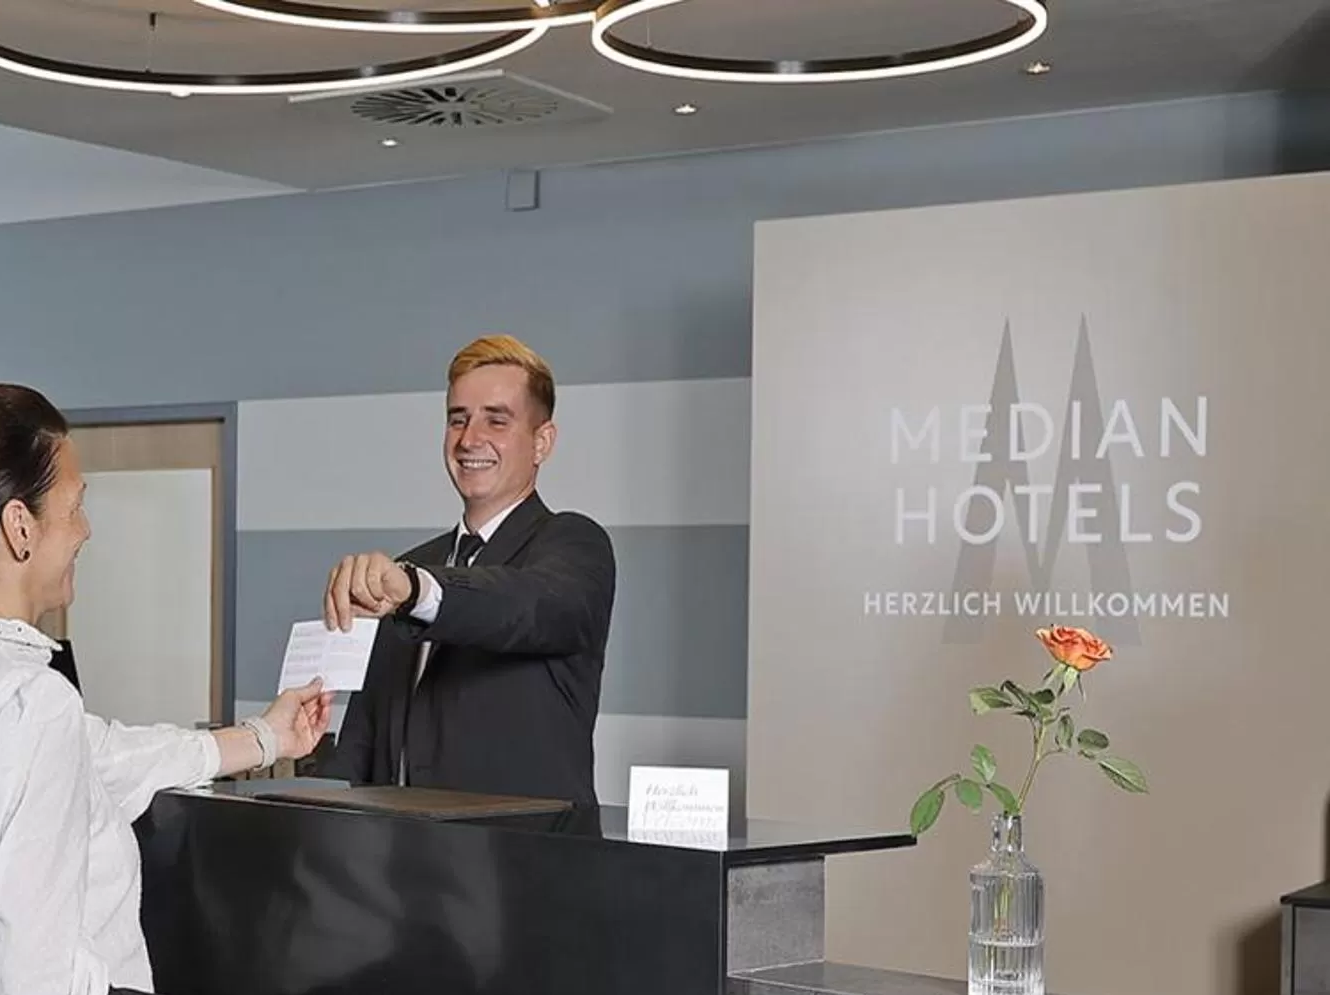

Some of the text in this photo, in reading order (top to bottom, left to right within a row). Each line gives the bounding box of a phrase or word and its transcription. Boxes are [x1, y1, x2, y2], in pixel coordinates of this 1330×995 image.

[888, 395, 1208, 465] MEDIAN
[894, 480, 1203, 545] HOTELS
[863, 591, 1230, 619] HERZLICH WILLKOMMEN
